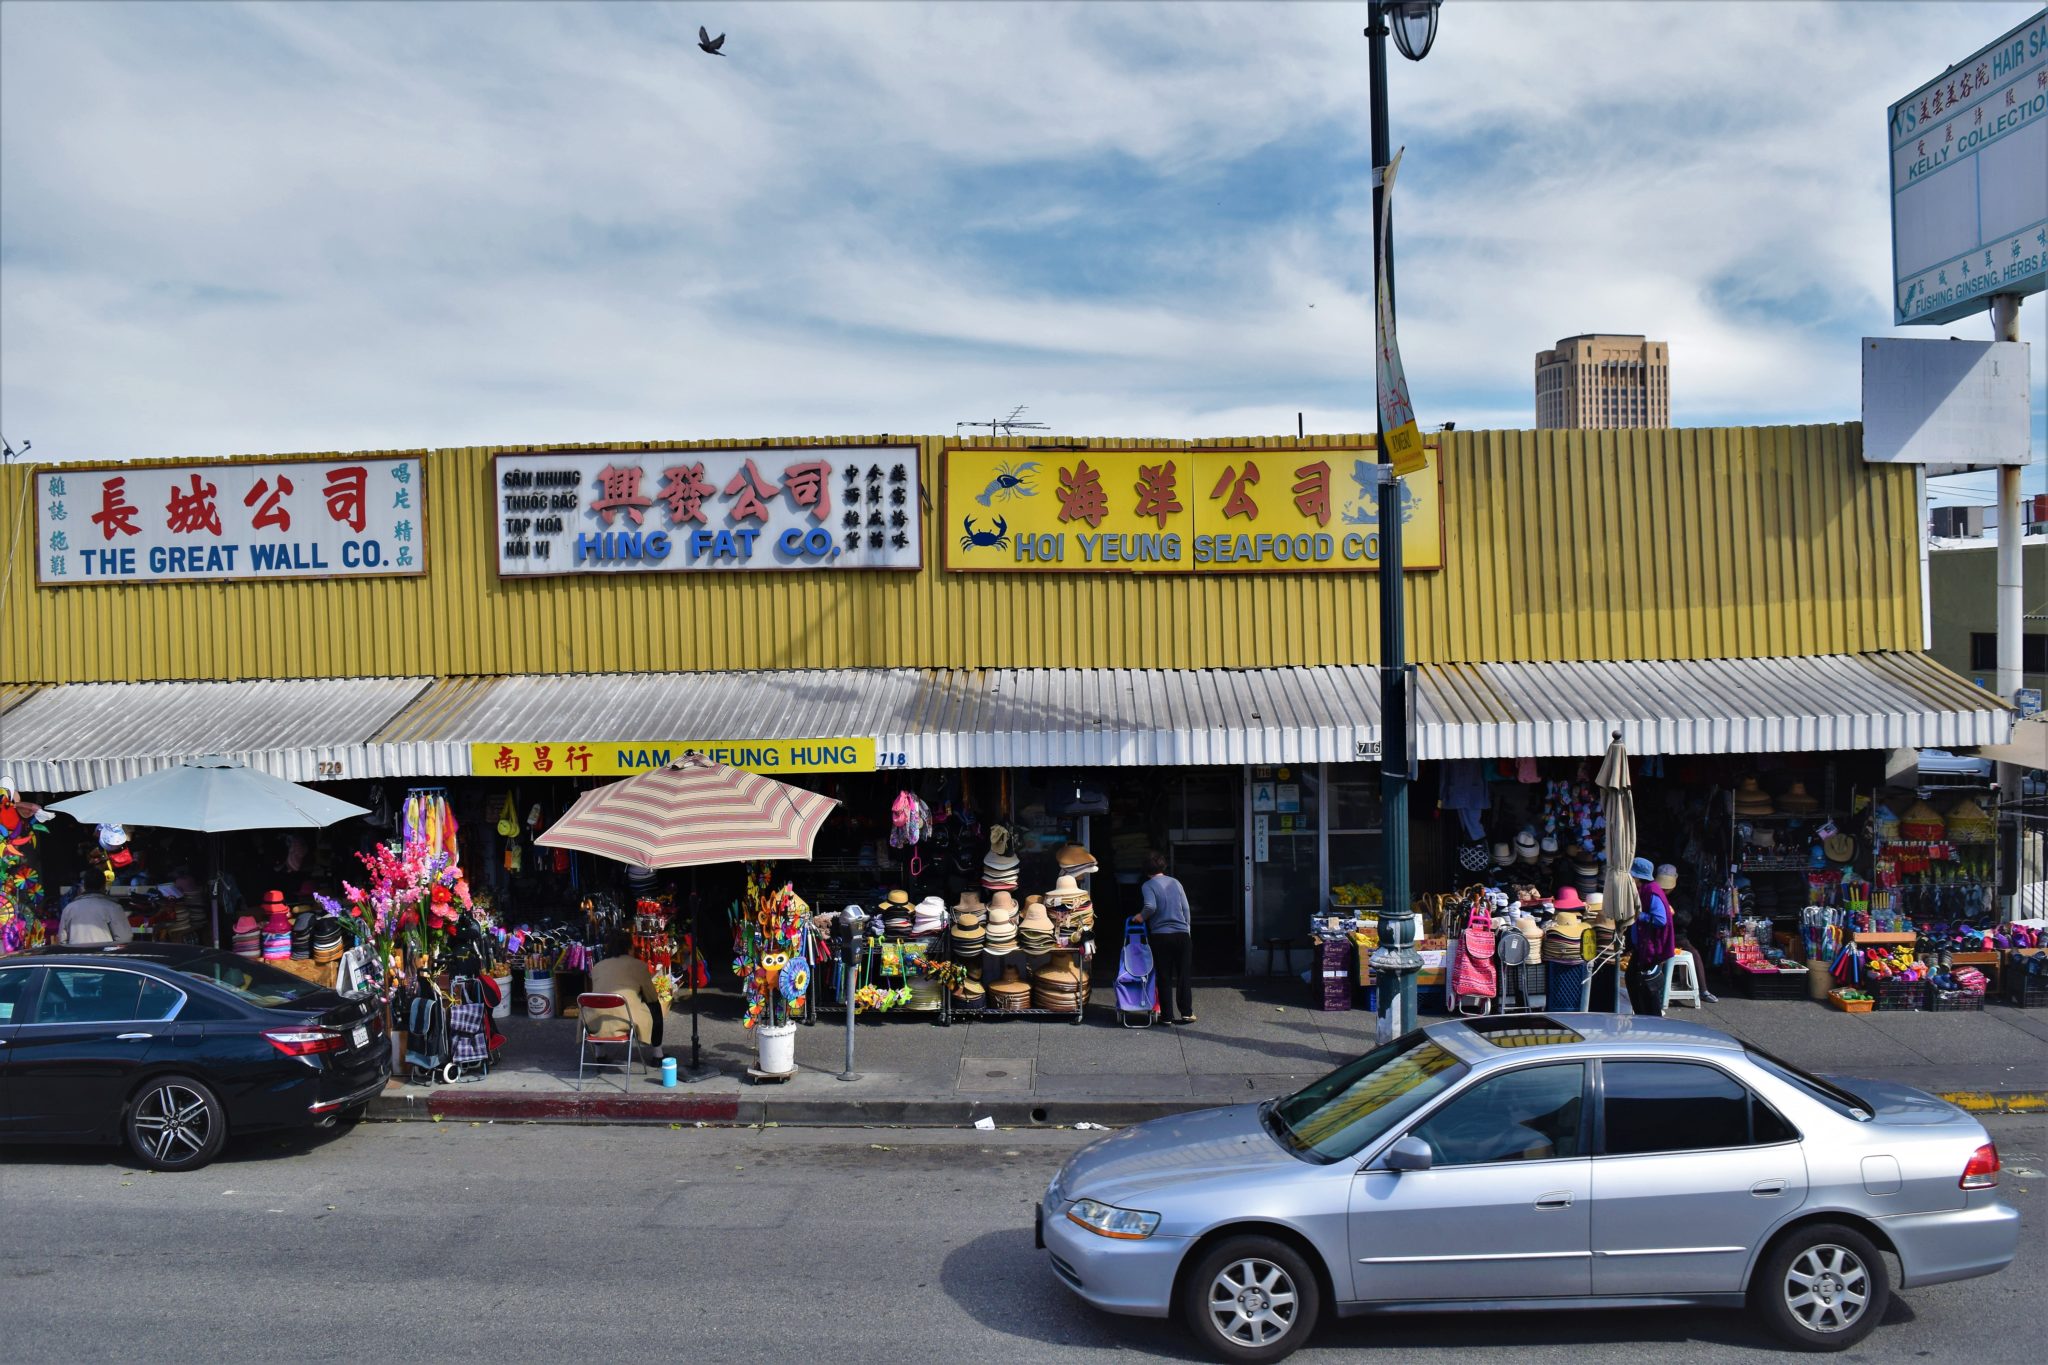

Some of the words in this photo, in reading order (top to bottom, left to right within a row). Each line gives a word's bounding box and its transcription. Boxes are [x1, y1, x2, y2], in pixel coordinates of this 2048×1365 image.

[1993, 39, 2024, 80] HAIR
[1909, 145, 1950, 180] KELLY
[1958, 94, 2048, 153] COLLECTIO
[1916, 288, 1953, 313] FUSHING
[2003, 255, 2038, 281] HERBS
[503, 469, 533, 487] SÂM
[536, 470, 581, 486] NHUNG
[590, 459, 833, 527] 興發公司
[1056, 459, 1333, 529] 海洋公司
[91, 466, 369, 542] 長城公司
[80, 547, 136, 575] THE
[149, 545, 239, 574] GREAT
[250, 542, 328, 570] WALL
[342, 540, 389, 568] CO.
[579, 530, 672, 560] HING
[692, 528, 760, 559] FAT
[779, 526, 841, 556] CO.
[1015, 532, 1065, 563] HOI
[1077, 532, 1182, 562] YEUNG
[1194, 532, 1335, 563] SEAFOOD
[494, 745, 593, 774] 南昌行
[617, 749, 670, 768] NAM
[791, 745, 857, 765] HUNG
[880, 752, 906, 766] 718
[1359, 743, 1380, 753] 716
[319, 761, 342, 774] 720
[1258, 787, 1270, 801] A
